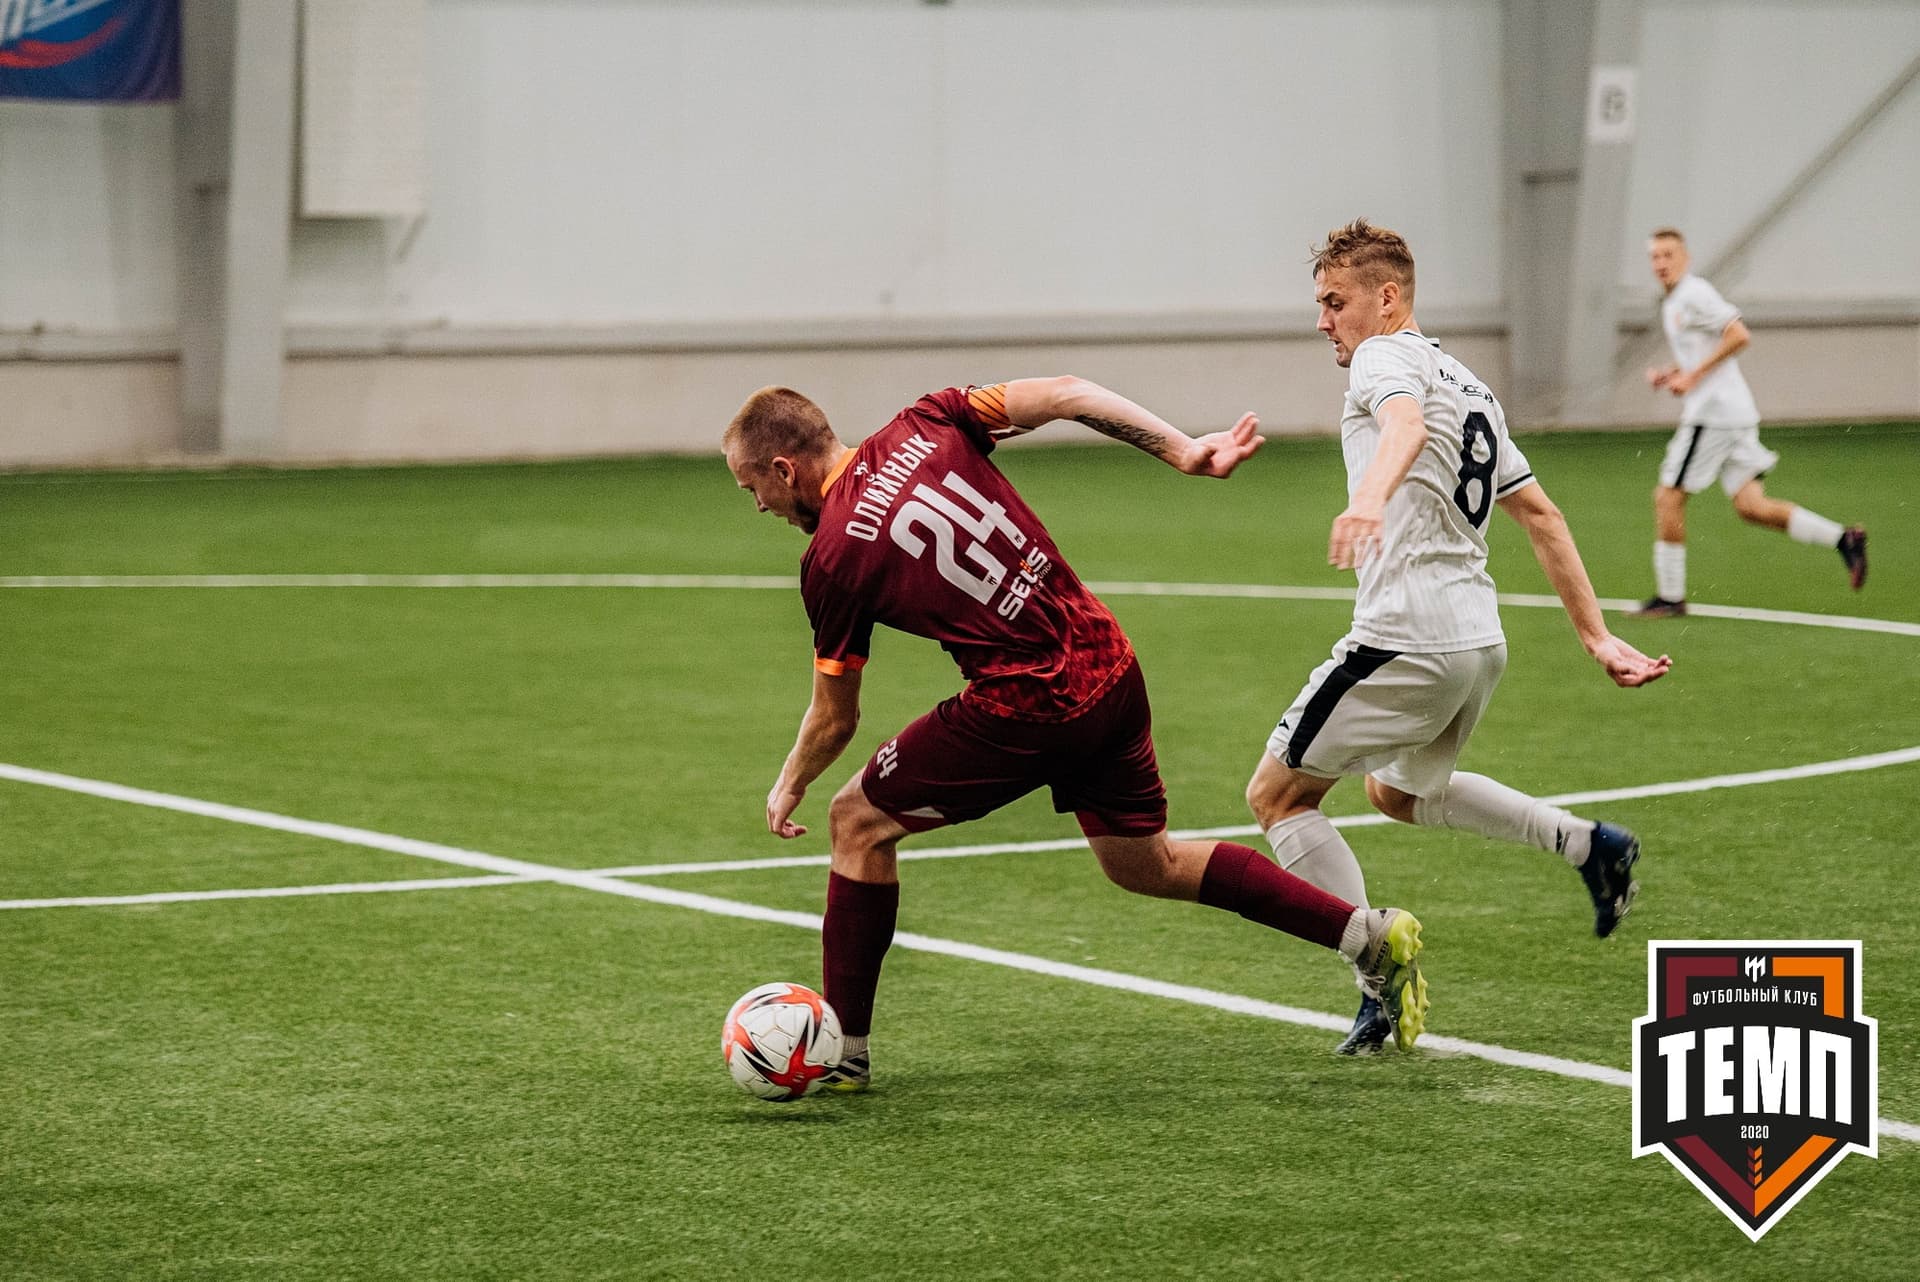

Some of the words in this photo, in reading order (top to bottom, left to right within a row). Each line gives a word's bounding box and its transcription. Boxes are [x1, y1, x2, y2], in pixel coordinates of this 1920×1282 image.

[845, 433, 938, 542] ОЛИЙНЫК
[1453, 410, 1498, 530] 8
[890, 471, 1027, 606] 24
[876, 738, 898, 780] 24
